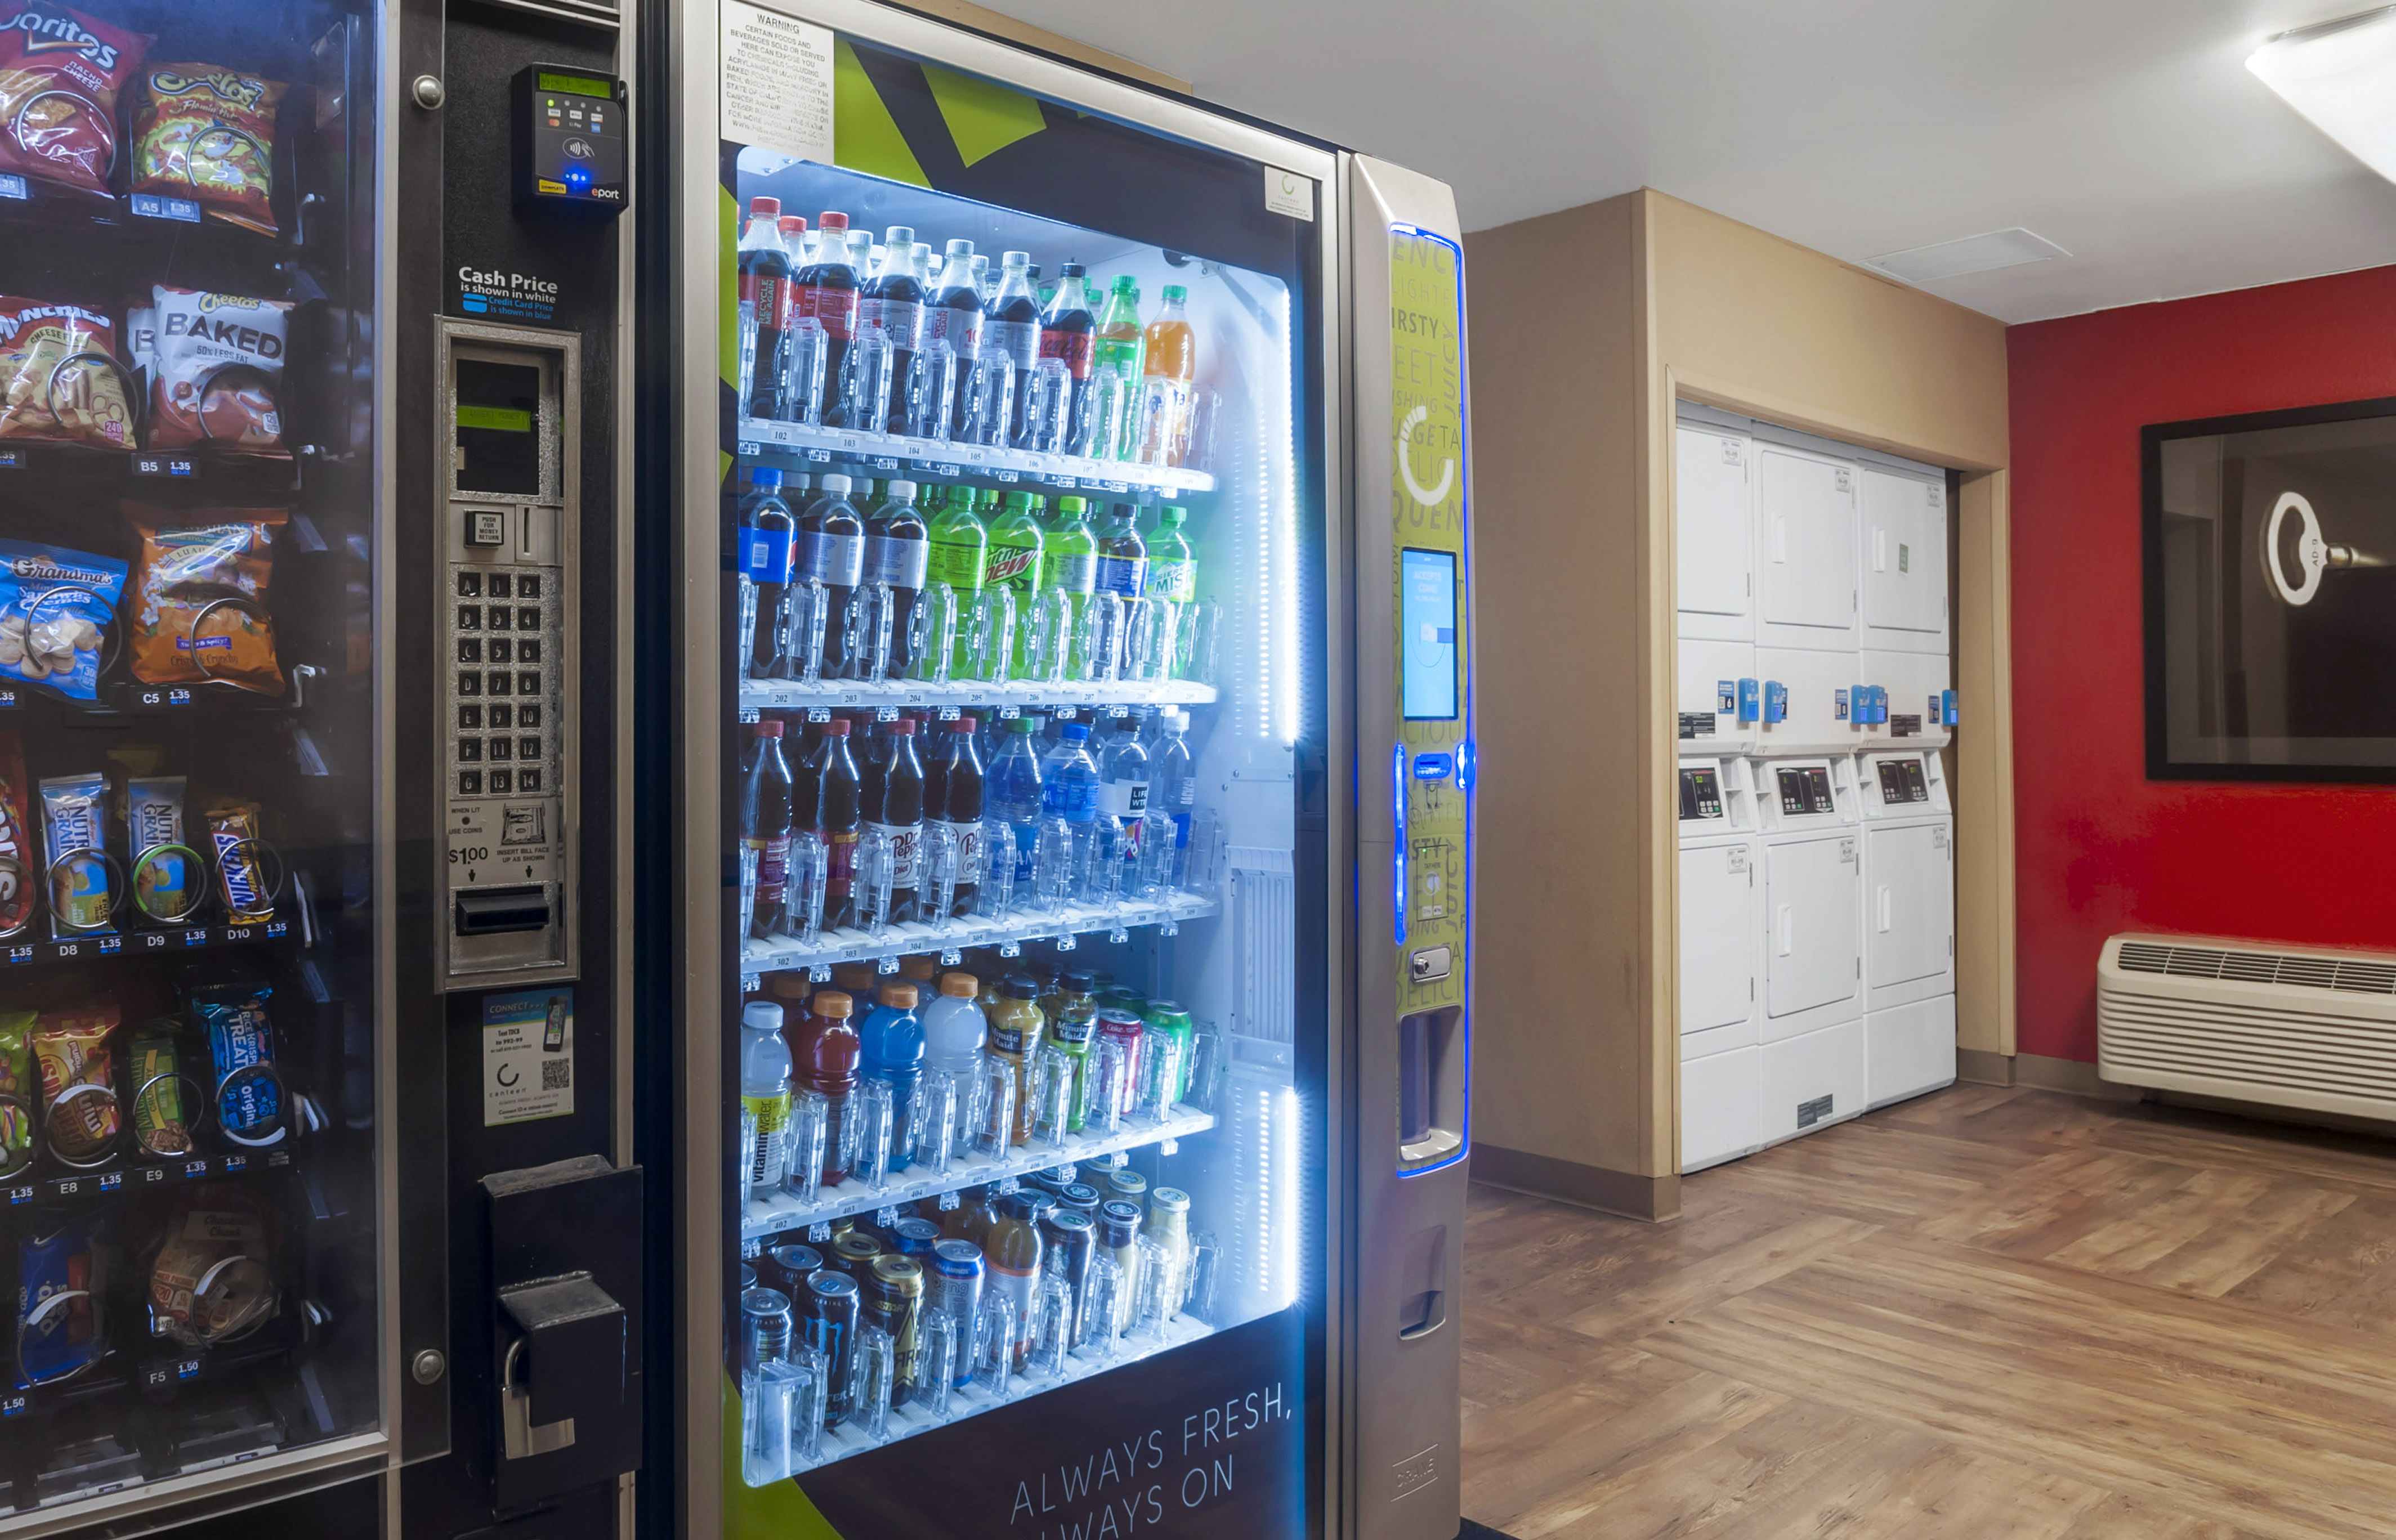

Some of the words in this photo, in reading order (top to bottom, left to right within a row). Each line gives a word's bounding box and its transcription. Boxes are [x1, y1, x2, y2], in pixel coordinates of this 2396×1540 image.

[757, 13, 800, 34] WARNING
[745, 25, 773, 38] CERTAIN
[798, 41, 811, 50] AND
[731, 29, 770, 46] BEVERAGES
[771, 41, 788, 51] SOLD
[800, 49, 825, 62] SERVED
[737, 48, 746, 57] TO
[741, 41, 759, 52] HERE
[760, 47, 774, 56] CAN
[802, 58, 815, 68] YOU
[592, 187, 619, 200] eport
[141, 202, 159, 213] A5
[170, 203, 191, 214] 1.35
[459, 266, 506, 286] Cash
[512, 274, 558, 294] Price
[461, 281, 470, 292] is
[472, 284, 509, 297] shown
[513, 290, 522, 299] in
[525, 292, 556, 303] white
[199, 293, 262, 314] Cheetos
[489, 296, 512, 306] Credit
[515, 299, 533, 309] Card
[534, 302, 554, 312] Price
[758, 279, 768, 325] RECYCLE
[498, 307, 524, 317] shown
[535, 311, 552, 320] blue
[764, 311, 772, 325] ME
[165, 313, 282, 360] BAKED
[214, 347, 234, 360] LESS
[235, 353, 248, 364] FAT
[775, 431, 787, 440] 102
[141, 462, 158, 472] B5
[170, 462, 191, 471] 1.35
[12, 558, 113, 585] Grandma's
[464, 580, 471, 592] A
[497, 581, 500, 592] 1
[525, 581, 530, 594] 2
[465, 614, 471, 625] B
[495, 614, 501, 625] 3
[525, 614, 531, 625] 4
[465, 646, 471, 657] C
[496, 646, 501, 657] 5
[525, 646, 530, 657] 6
[206, 652, 239, 665] Crunchy
[465, 679, 471, 691] D
[496, 679, 502, 690] 7
[525, 679, 530, 690] 8
[143, 693, 160, 704] C5
[169, 691, 190, 700] 1.35
[1727, 698, 1732, 708] 6
[466, 713, 471, 724] E
[496, 711, 501, 723] 9
[523, 711, 534, 723] 10
[466, 745, 471, 756] F
[494, 744, 504, 756] 11
[524, 743, 534, 755] 12
[466, 777, 472, 790] G
[494, 776, 504, 789] 13
[524, 775, 534, 787] 14
[905, 830, 919, 843] Dr
[449, 847, 489, 866] $1.00
[894, 864, 909, 875] Diet
[227, 928, 250, 940] D10
[266, 923, 287, 933] 1.35
[147, 936, 165, 947] D9
[185, 931, 206, 941] 1.35
[972, 934, 983, 943] 305
[100, 938, 122, 949] 1.35
[10, 947, 33, 957] 1.35
[59, 945, 78, 957] D8
[844, 950, 856, 958] 303
[776, 958, 789, 966] 302
[490, 1002, 528, 1014] CONNECT
[242, 1011, 253, 1033] RICE
[1057, 1021, 1088, 1033] Minute
[228, 1014, 251, 1067] TREAT
[1060, 1030, 1083, 1041] Maid
[489, 1087, 527, 1098] canteen
[226, 1156, 247, 1166] 1.35
[185, 1162, 206, 1173] 1.35
[100, 1175, 122, 1186] 1.35
[146, 1170, 163, 1181] E9
[10, 1188, 33, 1199] 1.35
[60, 1182, 78, 1194] E8
[911, 1189, 923, 1198] 404
[843, 1205, 855, 1215] 403
[774, 1220, 787, 1229] 402
[932, 1274, 969, 1297] bang
[178, 1361, 199, 1373] 1.50
[150, 1371, 166, 1384] F5
[3, 1398, 25, 1410] 1.50
[1011, 1429, 1164, 1526] ALWAYS
[1183, 1382, 1292, 1456] FRESH,
[1182, 1453, 1233, 1508] ON
